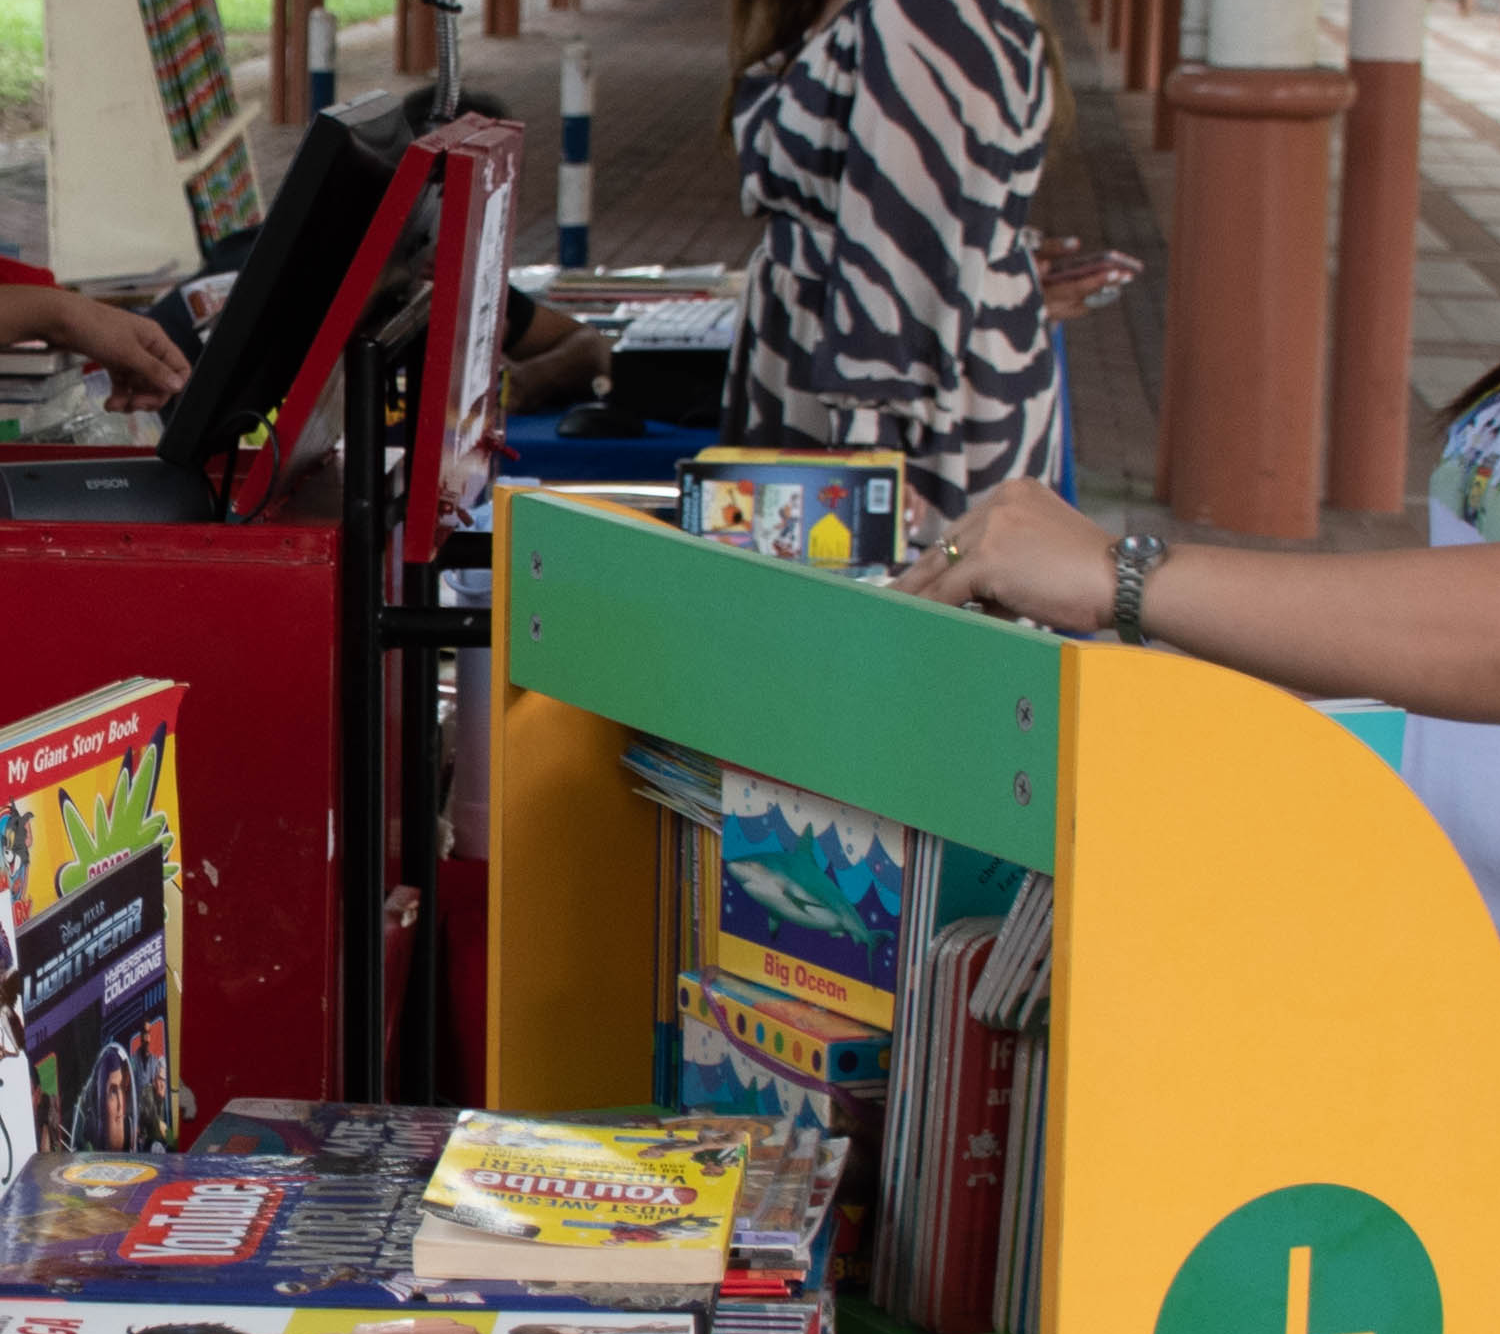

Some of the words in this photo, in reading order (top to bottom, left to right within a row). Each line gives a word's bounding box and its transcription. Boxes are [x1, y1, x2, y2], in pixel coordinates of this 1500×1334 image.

[84, 477, 128, 490] EPSON
[7, 758, 29, 784] My
[33, 742, 68, 774] Giant
[71, 730, 104, 760] Story
[108, 712, 140, 744] Book
[22, 898, 143, 1012] LIGHTYEAR
[103, 934, 163, 987] HYPERSPACE
[103, 954, 163, 1005] COLOURING
[761, 950, 790, 987] Big
[791, 961, 849, 1004] Ocean
[472, 1170, 682, 1206] YouTube
[479, 1157, 568, 1178] EVER!
[577, 1168, 688, 1185] VIDEOS
[128, 1182, 269, 1259] YouTube
[606, 1204, 681, 1218] MOST
